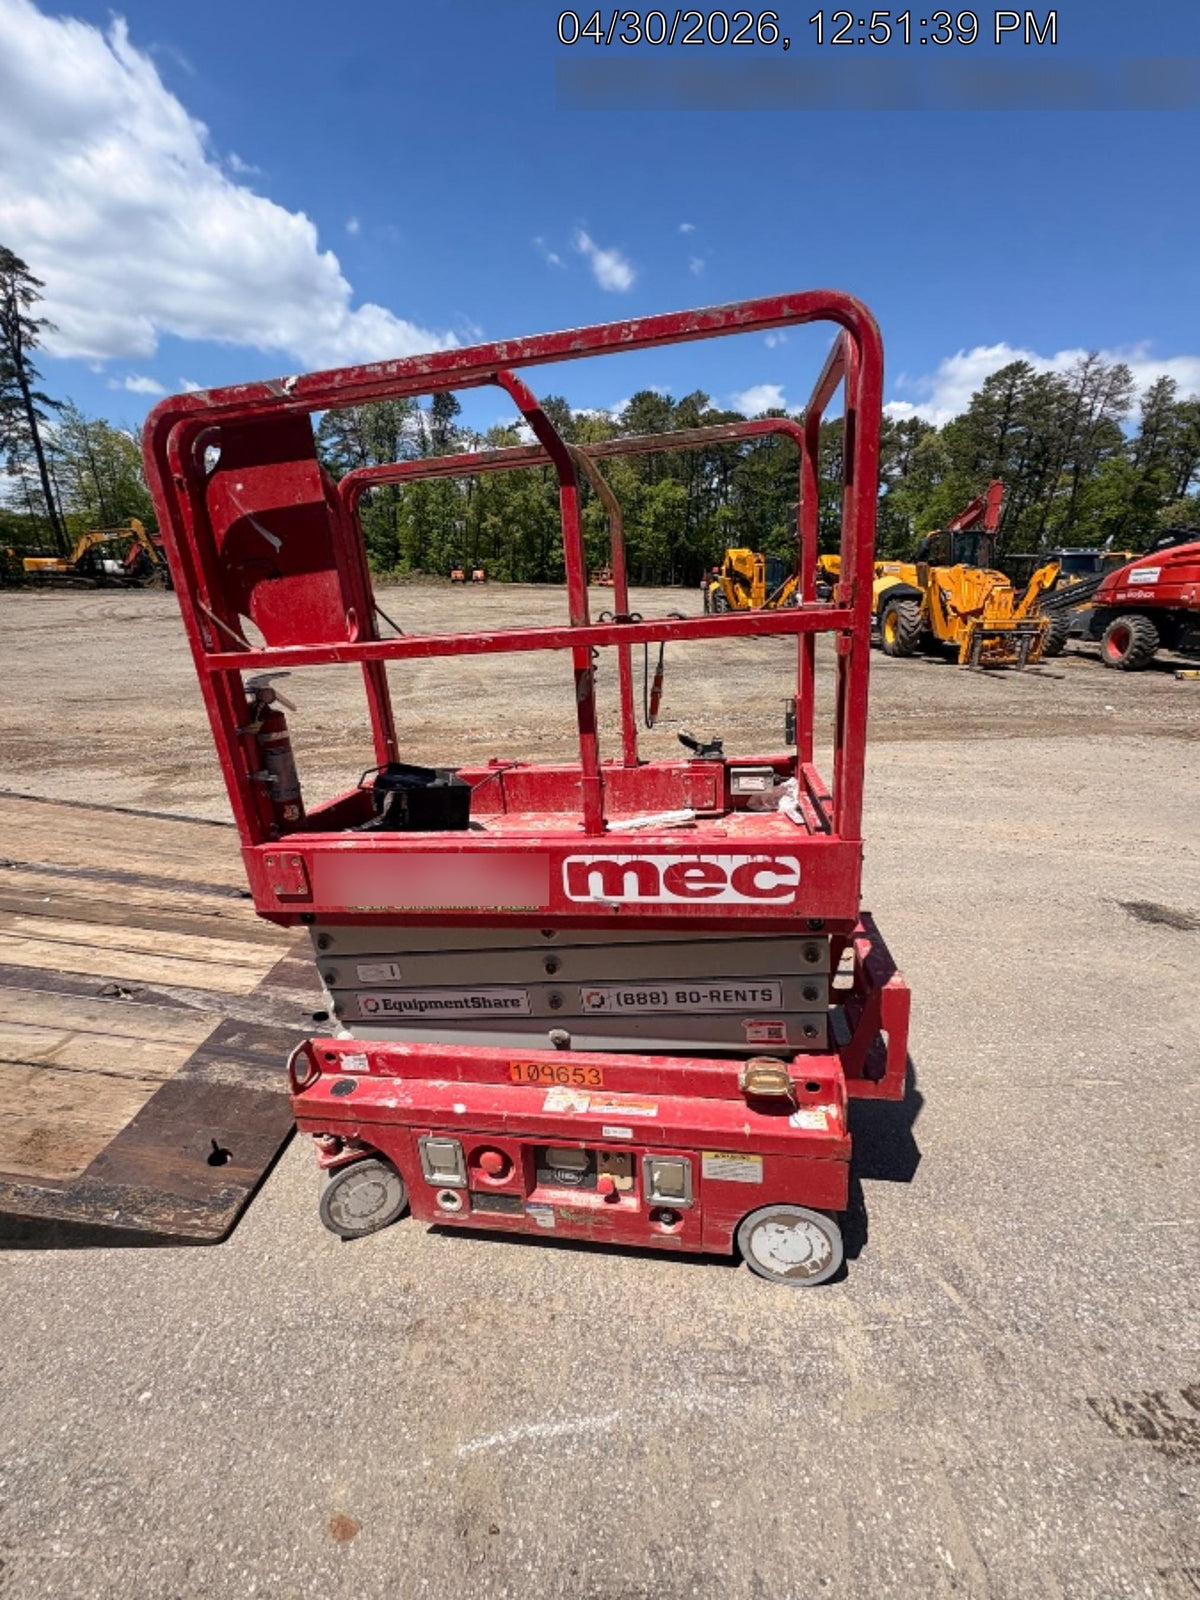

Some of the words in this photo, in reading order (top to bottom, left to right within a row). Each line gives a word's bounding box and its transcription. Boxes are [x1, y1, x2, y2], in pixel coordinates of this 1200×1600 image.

[566, 859, 799, 898] mec
[381, 997, 522, 1012] EquipmentShare
[616, 992, 668, 1006] (888)
[513, 1064, 601, 1085] 109653
